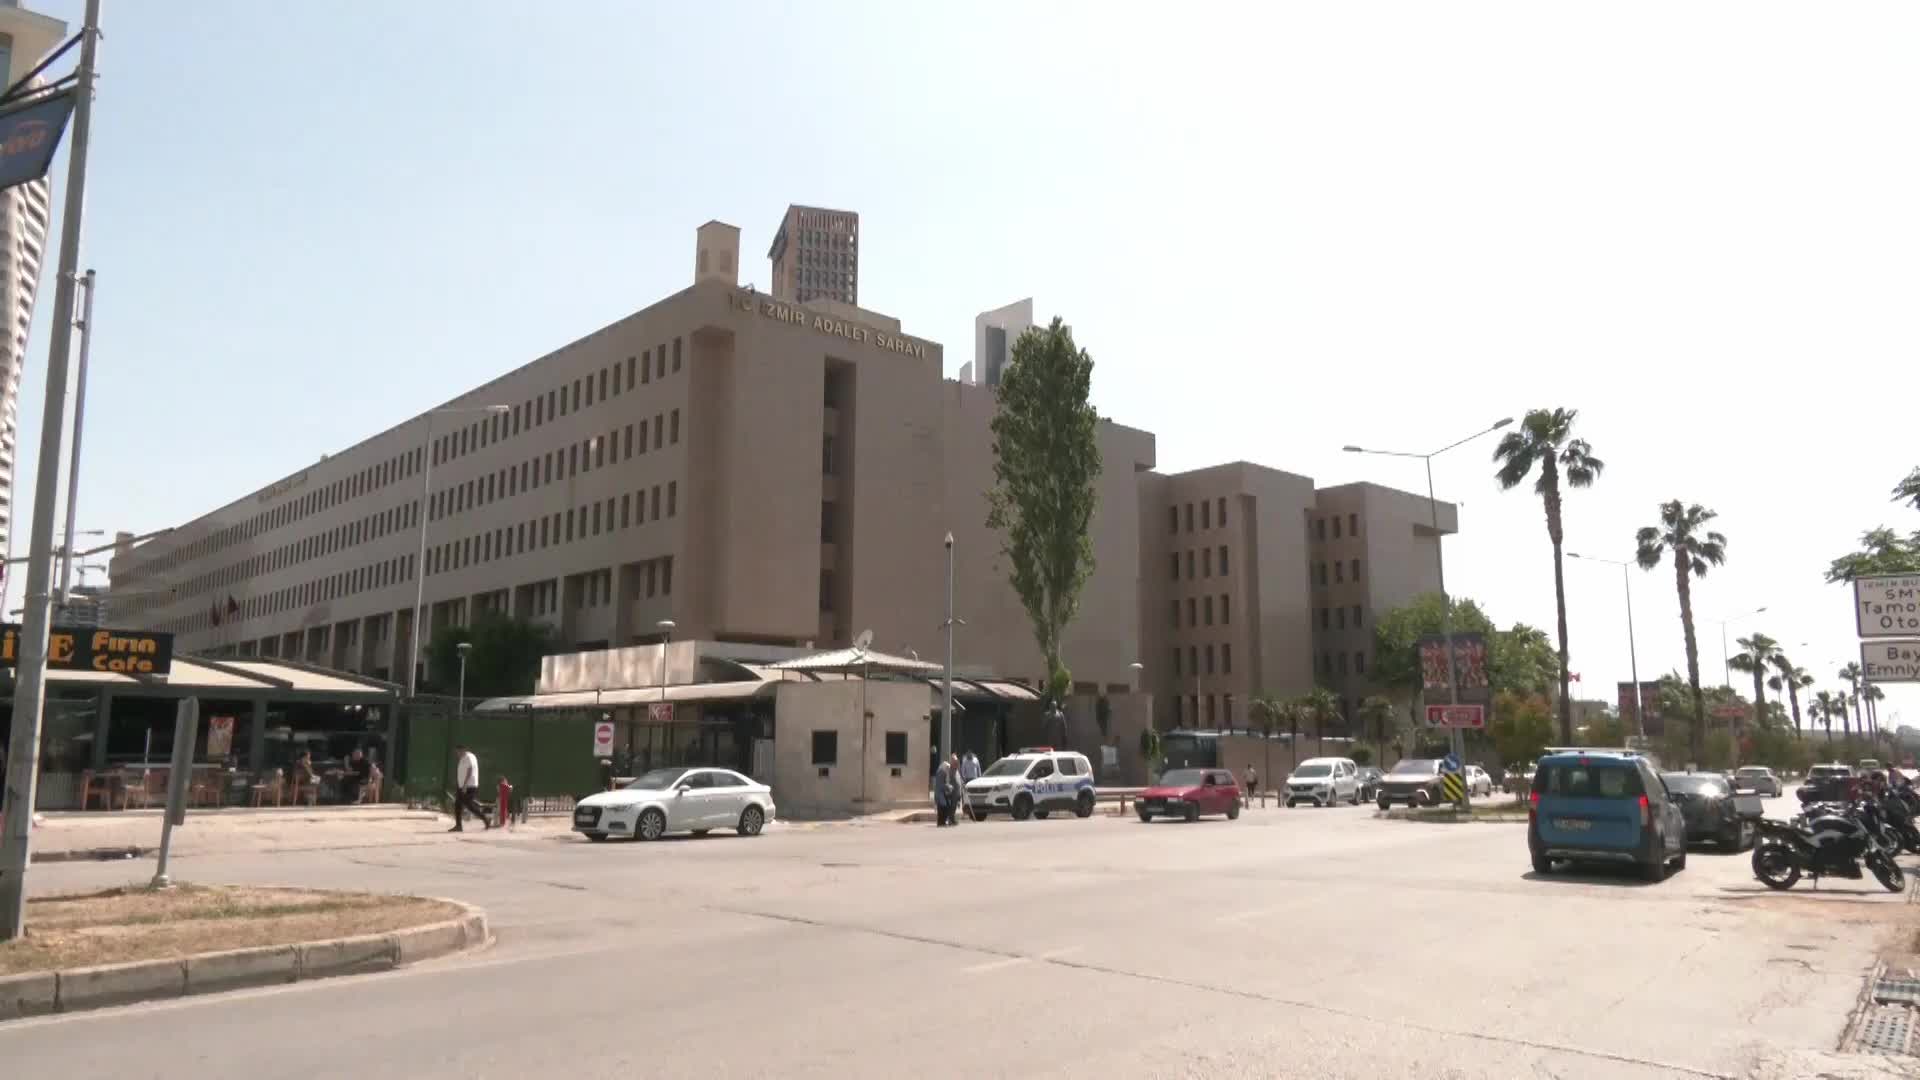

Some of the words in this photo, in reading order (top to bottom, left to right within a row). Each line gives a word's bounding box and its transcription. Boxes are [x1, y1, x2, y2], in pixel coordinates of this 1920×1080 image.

[813, 315, 869, 344] ADALET
[876, 333, 925, 359] SARAYI
[1863, 600, 1920, 614] Tamo
[1880, 615, 1919, 629] Oto
[92, 654, 154, 673] Cafe
